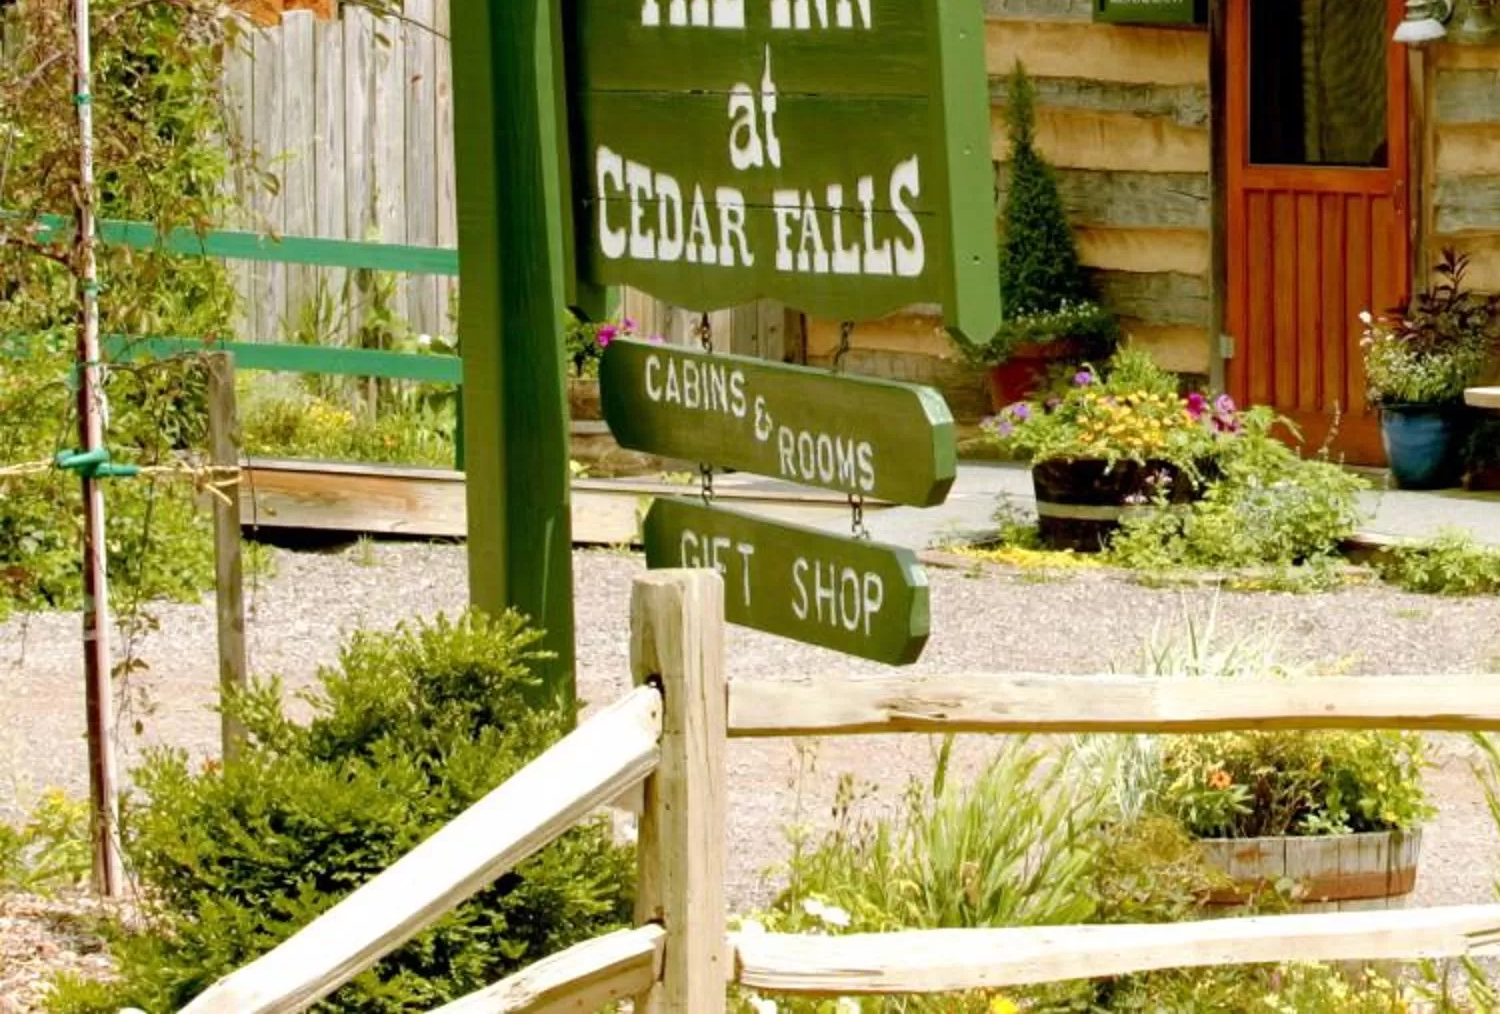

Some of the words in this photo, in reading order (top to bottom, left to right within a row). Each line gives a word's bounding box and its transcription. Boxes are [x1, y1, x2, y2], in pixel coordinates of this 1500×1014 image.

[728, 43, 781, 170] at
[596, 146, 754, 267] CEDAR
[772, 155, 926, 277] FALLS
[644, 355, 747, 418] CABINS
[753, 395, 773, 442] &
[778, 426, 876, 491] ROOMS
[790, 557, 884, 635] SHOP
